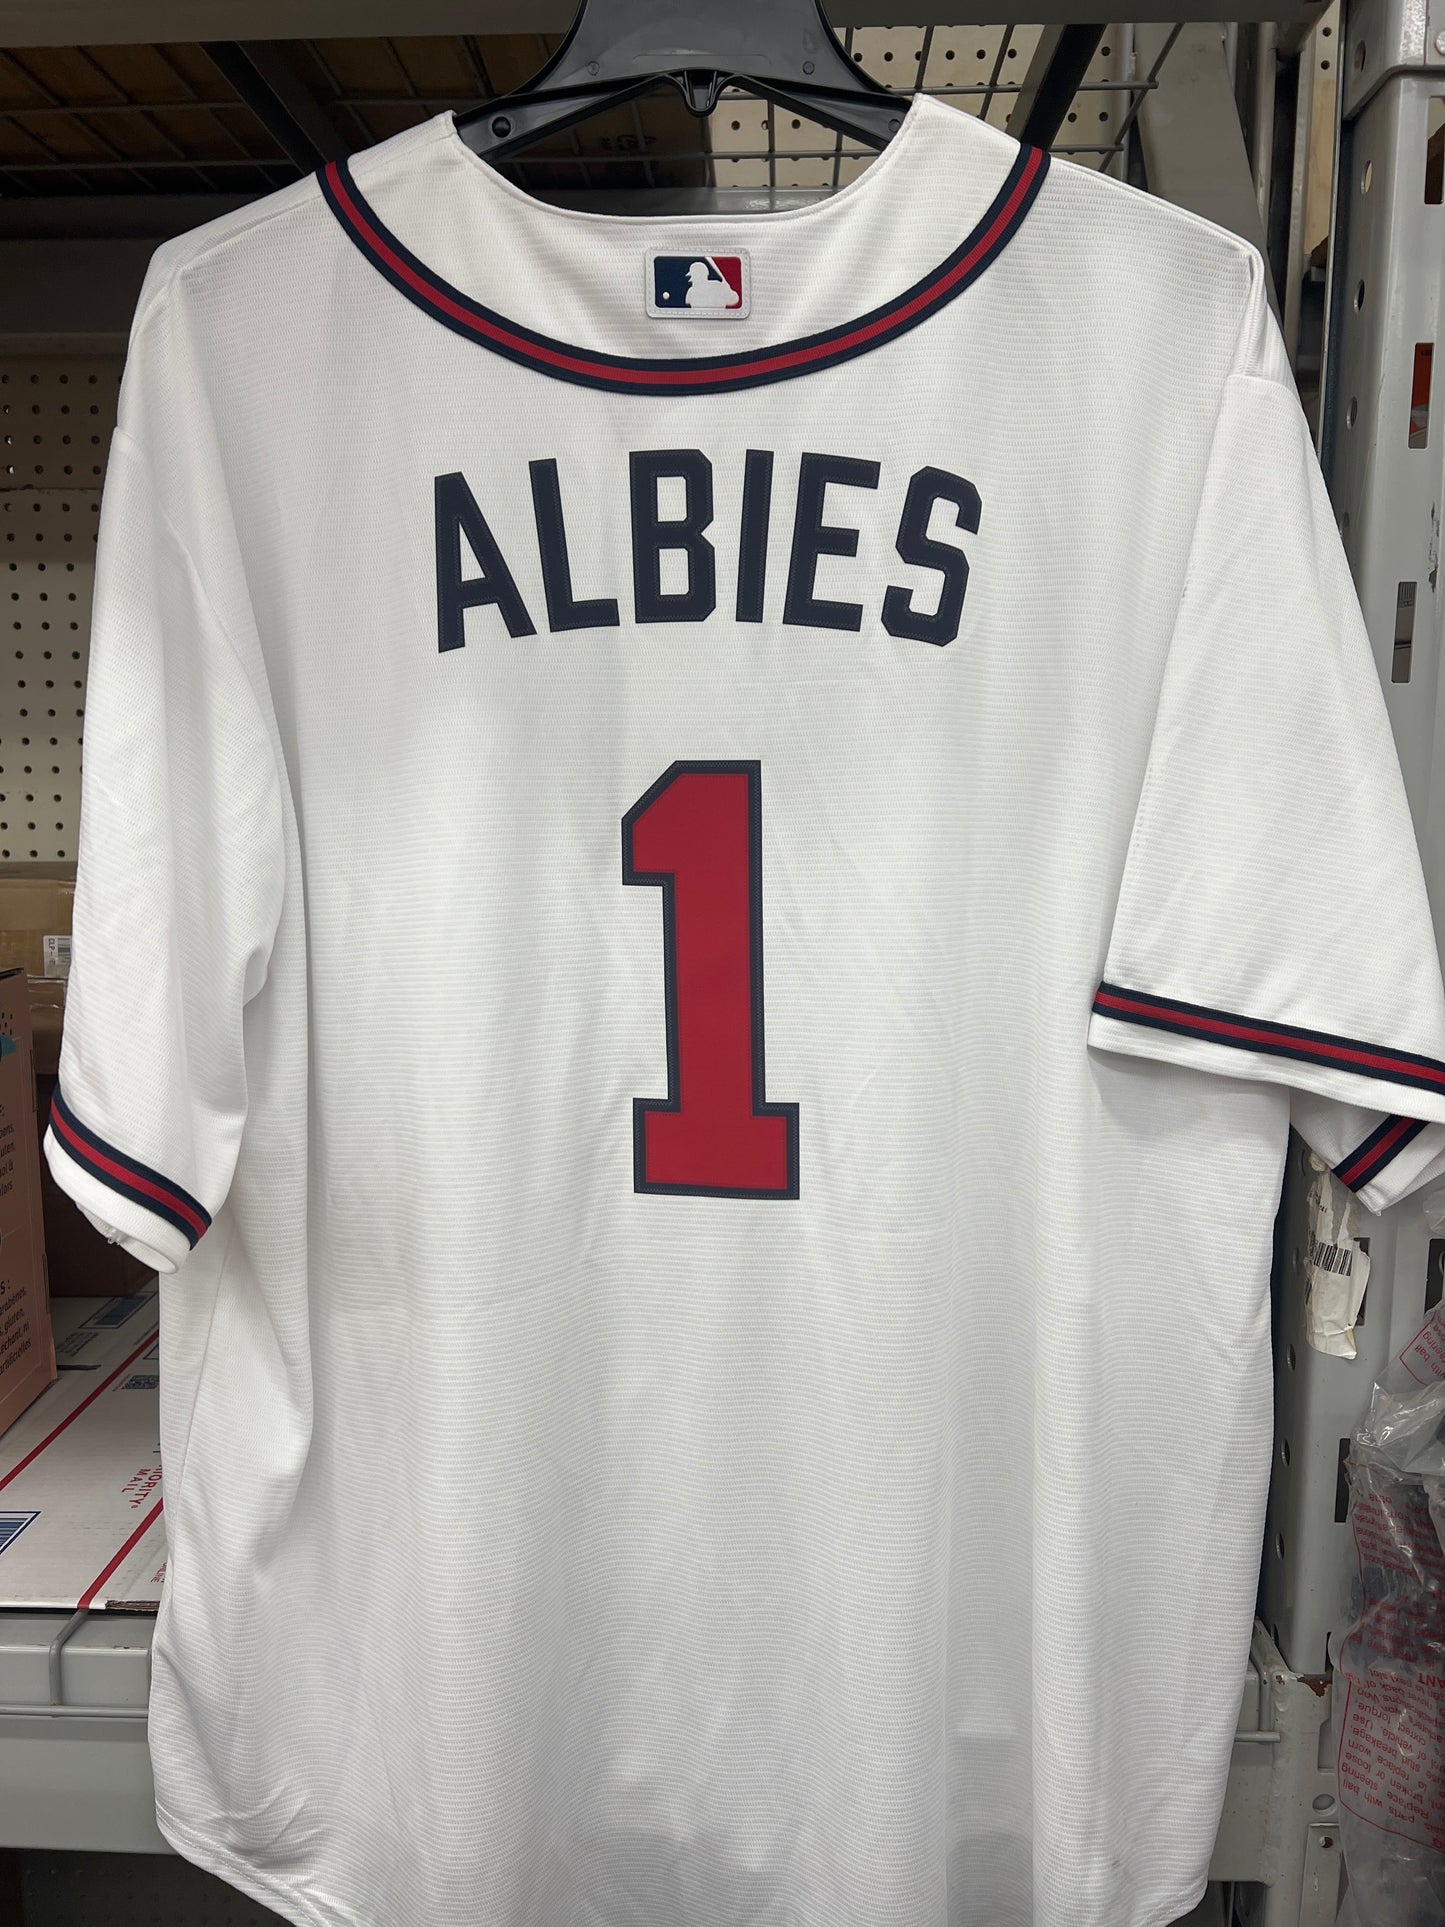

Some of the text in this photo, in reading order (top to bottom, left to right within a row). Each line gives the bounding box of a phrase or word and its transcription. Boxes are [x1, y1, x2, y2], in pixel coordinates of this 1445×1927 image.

[435, 449, 982, 653] ALBIES
[621, 760, 800, 1200] 1
[121, 1468, 151, 1493] MAIL
[1352, 1713, 1374, 1730] Use
[1355, 1699, 1391, 1725] torque.
[1348, 1739, 1371, 1758] worn
[1350, 1725, 1398, 1760] breakage,
[1345, 1752, 1371, 1774] loose
[1375, 1771, 1386, 1780] or
[1377, 1755, 1410, 1781] replace
[1341, 1762, 1378, 1791] steering
[1342, 1779, 1360, 1796] ball
[1363, 1792, 1383, 1808] with
[1390, 1778, 1423, 1805] broken
